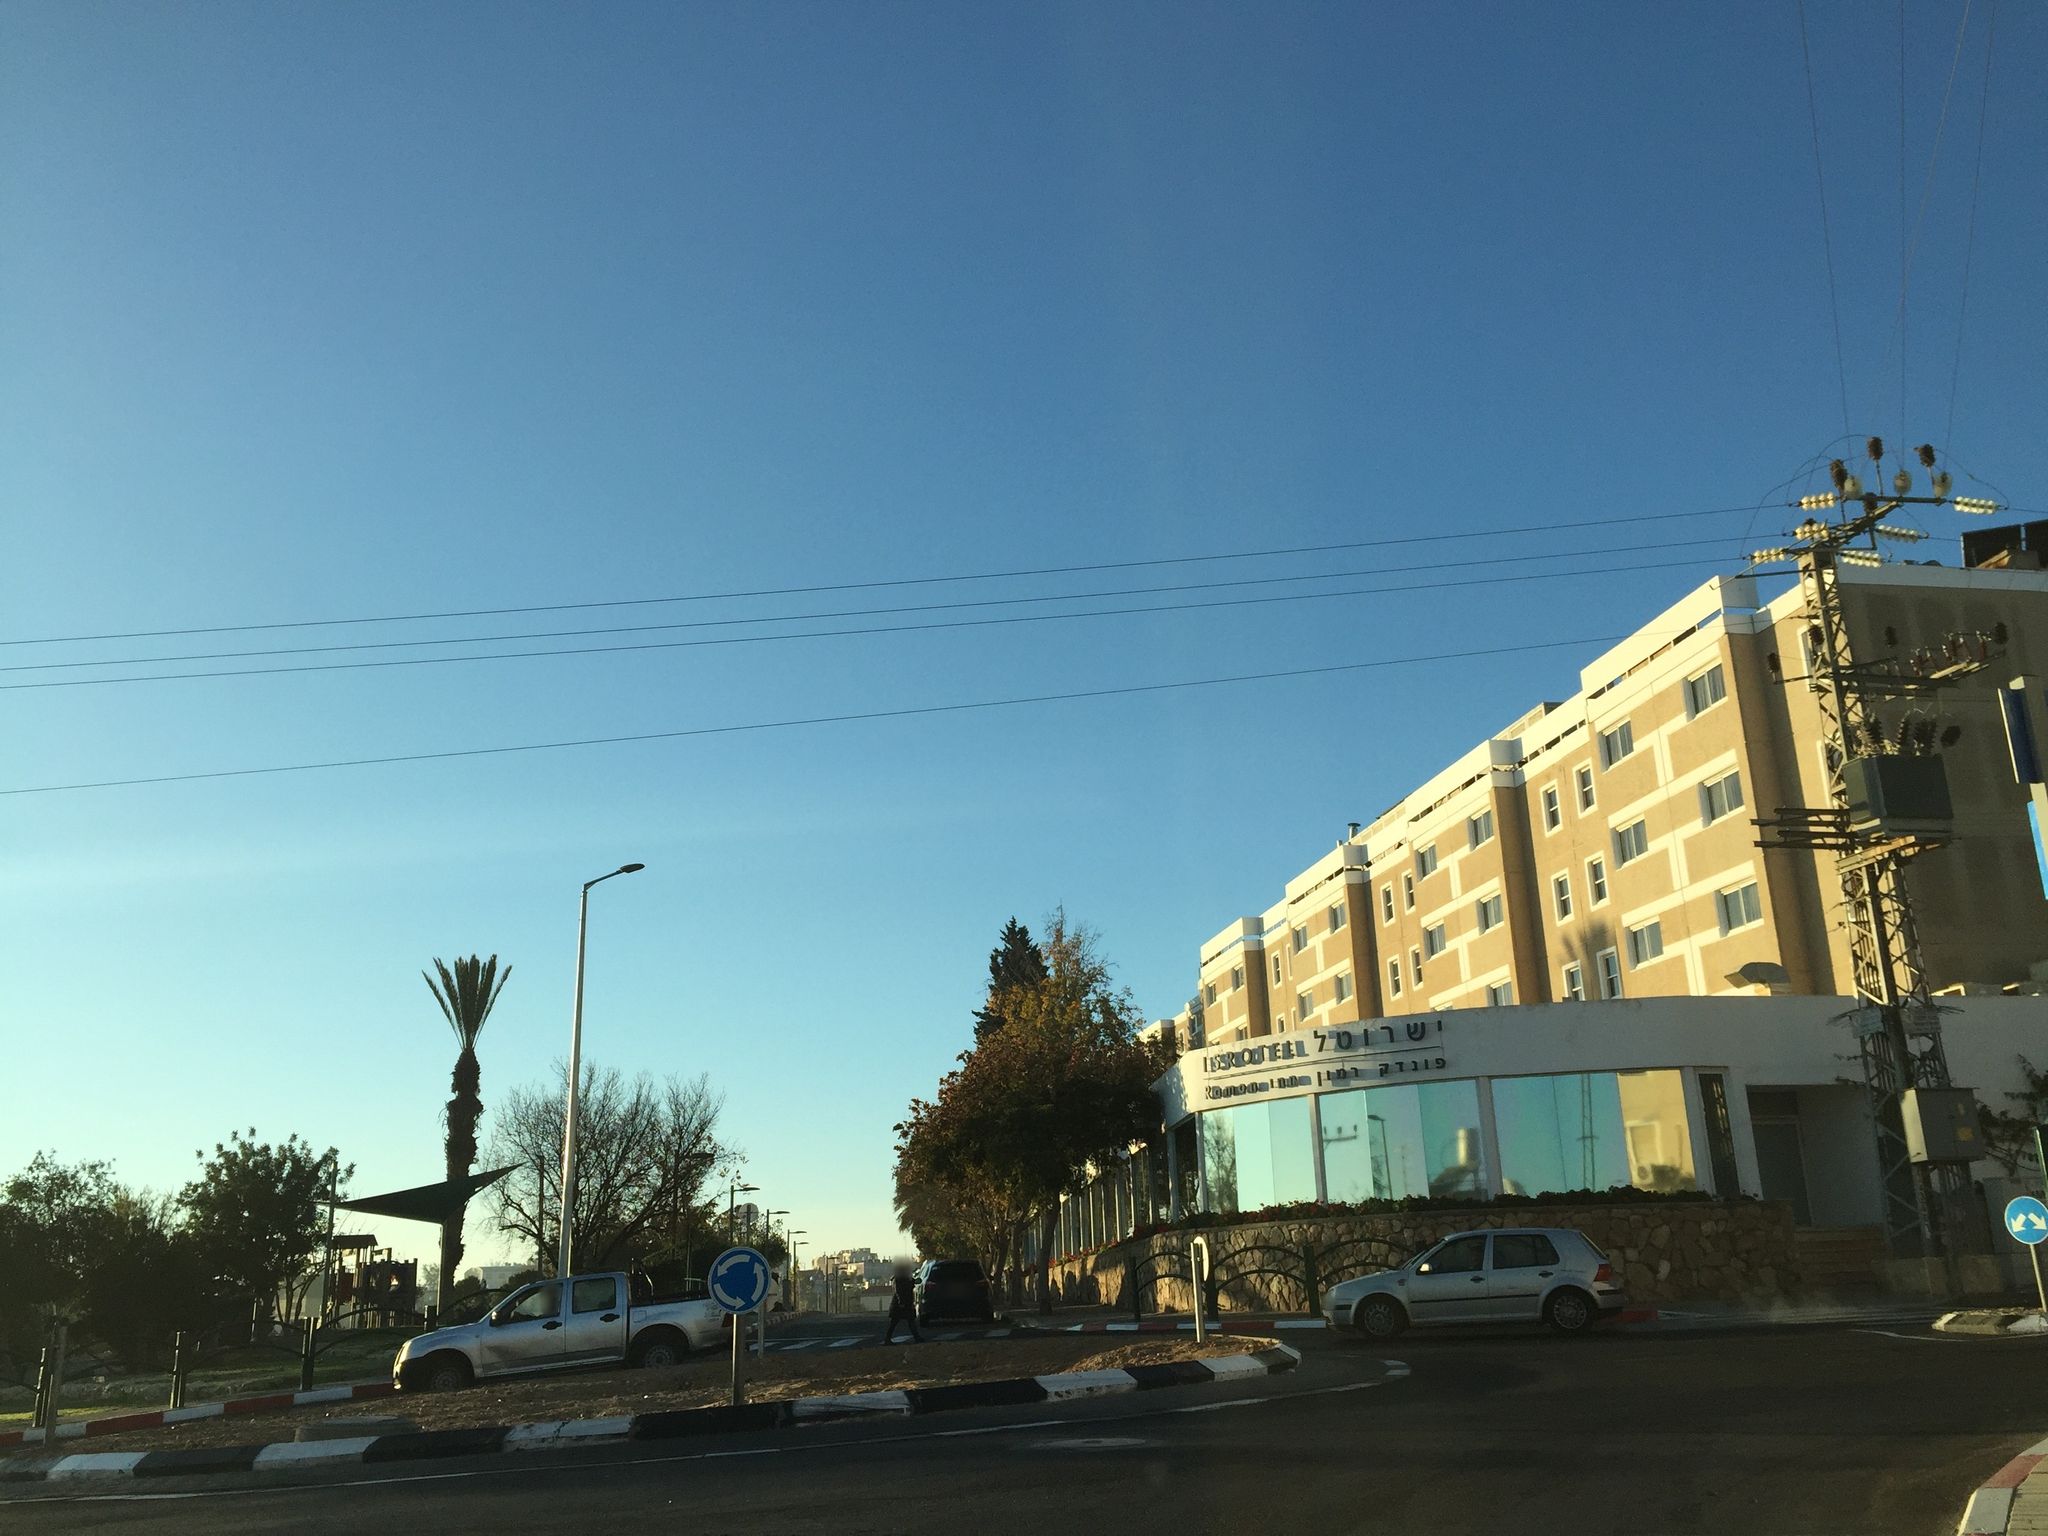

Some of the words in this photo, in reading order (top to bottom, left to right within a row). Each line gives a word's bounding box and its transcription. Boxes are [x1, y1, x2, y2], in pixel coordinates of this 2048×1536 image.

[1313, 1020, 1443, 1052] ישרוטל
[1203, 1040, 1308, 1073] ISROTEL
[1378, 1057, 1447, 1078] פונדק
[1316, 1066, 1360, 1087] רמון
